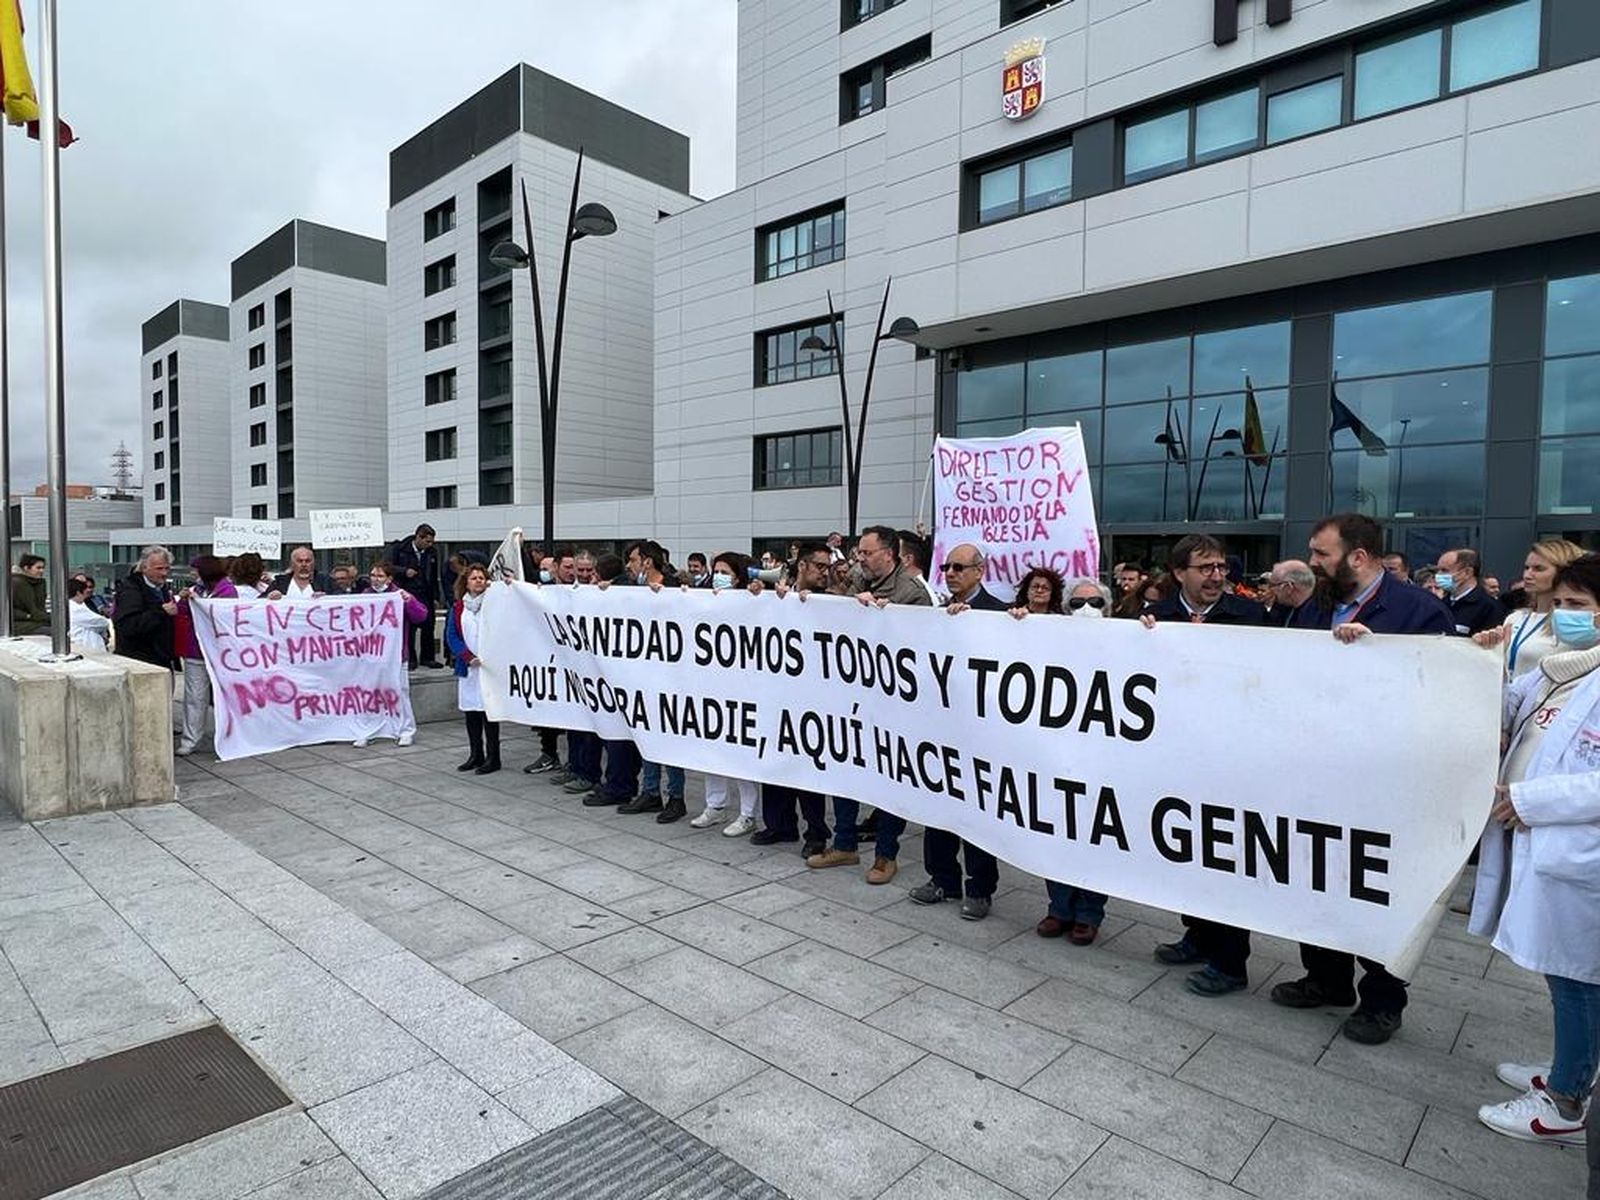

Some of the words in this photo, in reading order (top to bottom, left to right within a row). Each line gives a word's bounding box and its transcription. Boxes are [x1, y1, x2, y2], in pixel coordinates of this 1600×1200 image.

[938, 441, 1061, 479] DIRECTOR
[956, 470, 1081, 503] GESTION
[943, 505, 1020, 528] FERNANDO
[983, 520, 1049, 543] IGLESIA
[209, 600, 399, 638] LENCERIA
[221, 643, 279, 672] CON
[543, 612, 572, 648] LA
[566, 614, 683, 662] SANIDAD
[695, 622, 804, 677] SOMOS
[814, 632, 918, 702] TODOS
[929, 653, 954, 709] Y
[968, 657, 1157, 743] TODAS
[509, 654, 557, 708] AQUÍ
[660, 692, 767, 759] NADIE,
[778, 703, 865, 771] AQUÍ
[873, 726, 964, 802] HACE
[972, 757, 1131, 852] FALTA
[1151, 796, 1392, 907] GENTE
